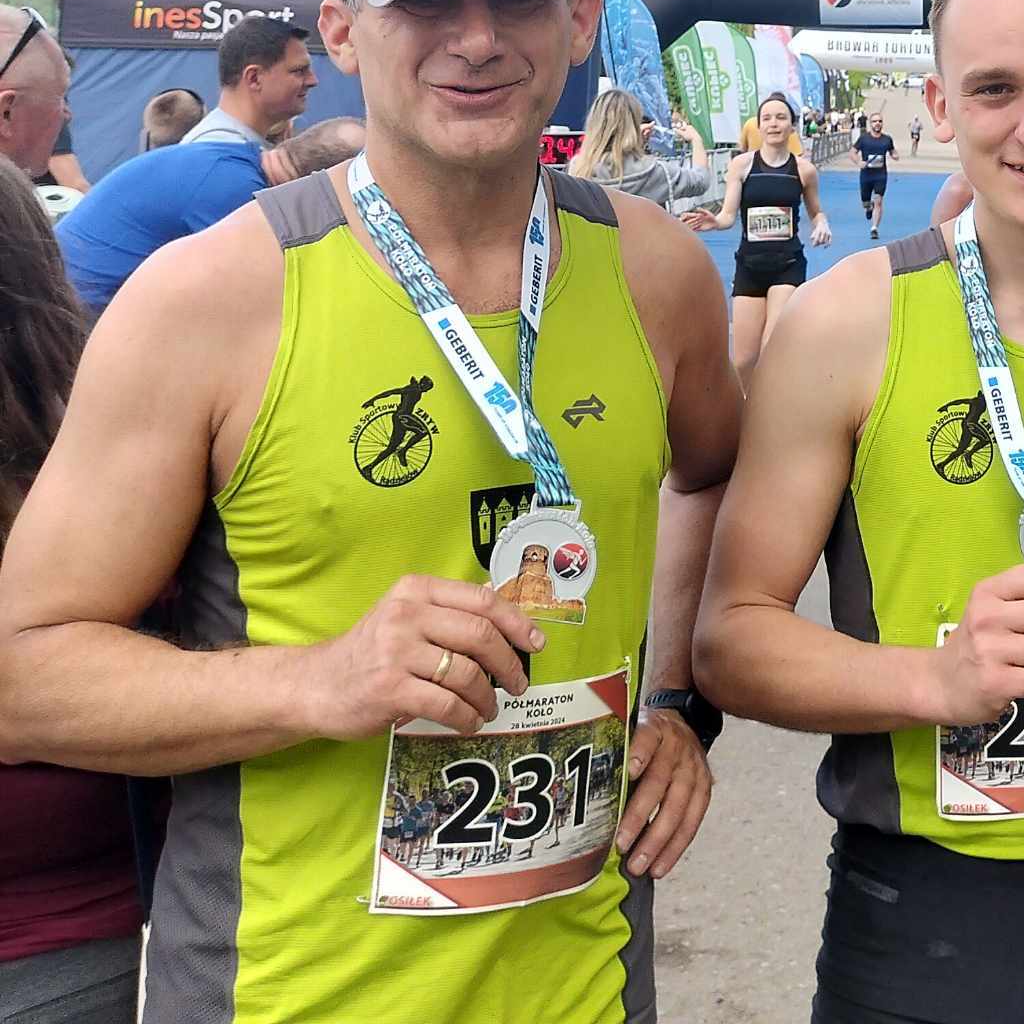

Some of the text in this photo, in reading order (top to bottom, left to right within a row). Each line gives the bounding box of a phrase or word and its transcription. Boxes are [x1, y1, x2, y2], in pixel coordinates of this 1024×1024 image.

[530, 254, 544, 305] GEBERIT
[445, 328, 485, 382] GEBERIT
[991, 388, 1013, 442] GEBERIT
[503, 693, 574, 710] PÓŁMARATON
[526, 707, 554, 719] KOŁO
[432, 744, 594, 848] 231
